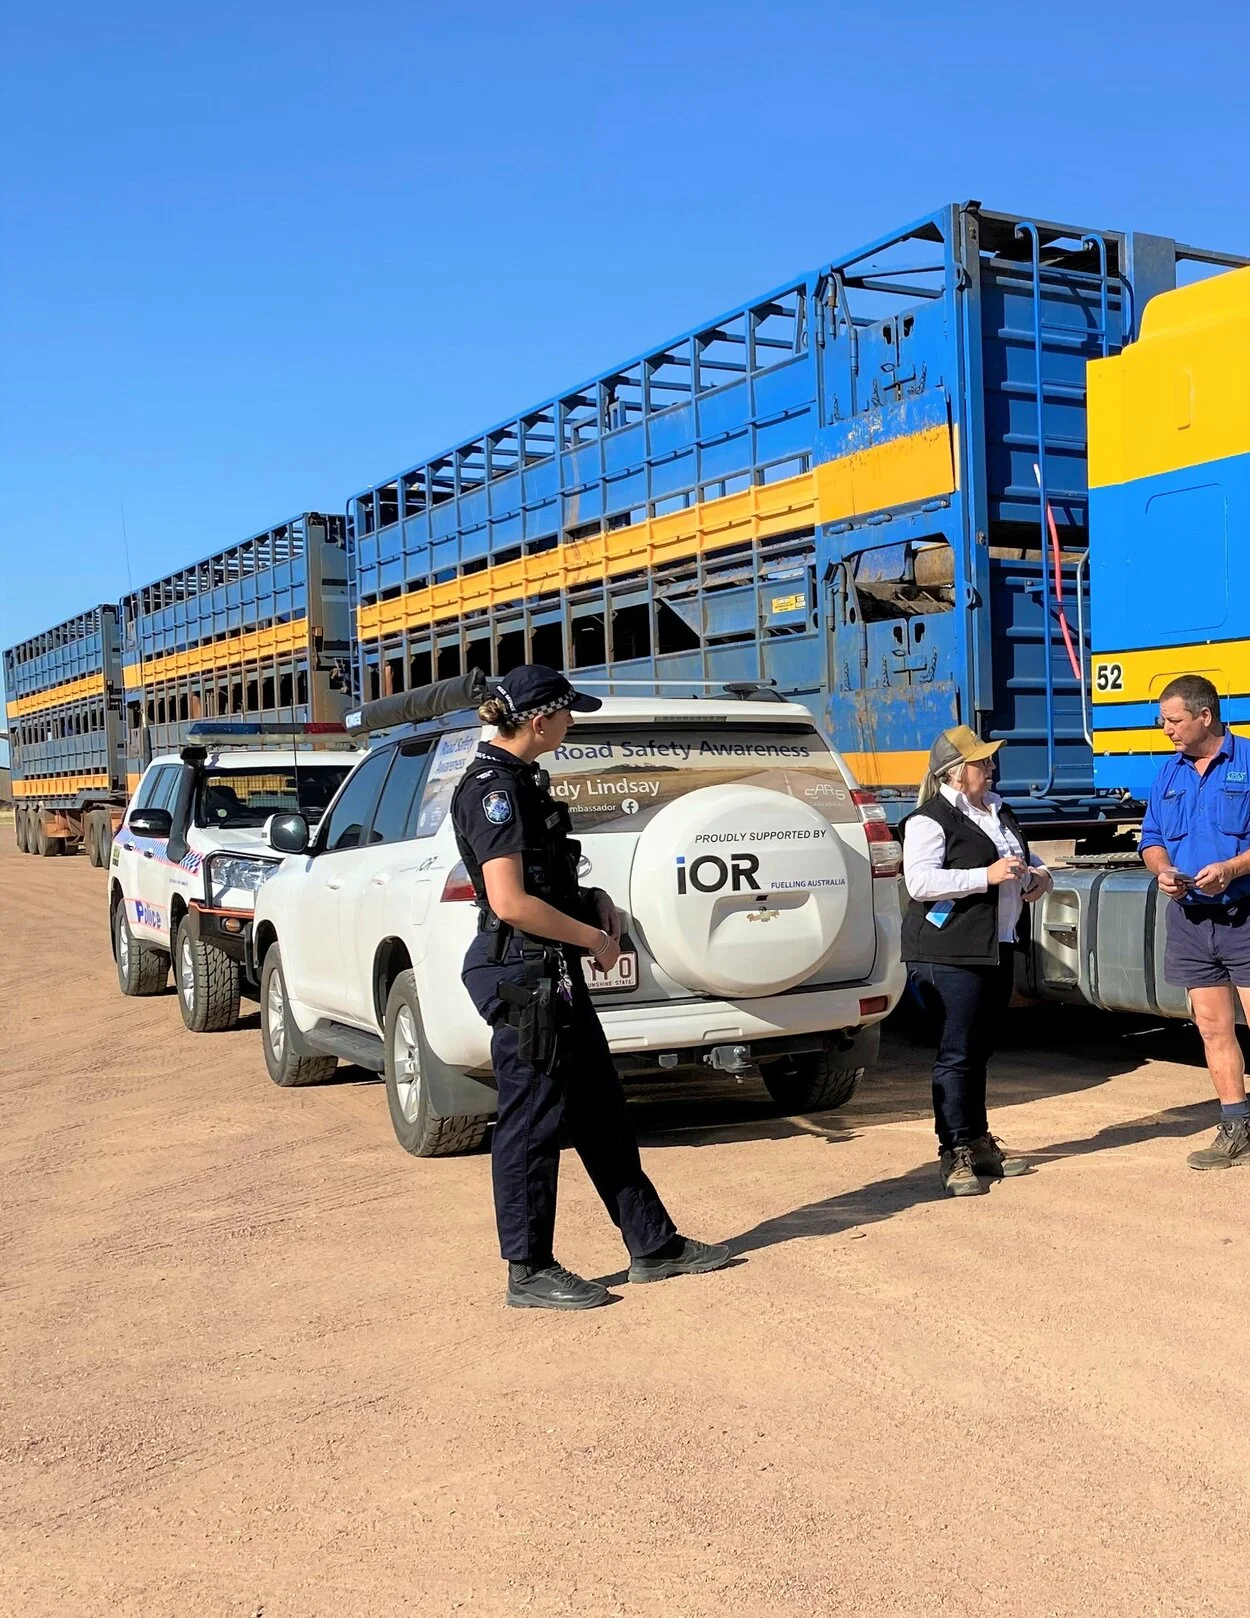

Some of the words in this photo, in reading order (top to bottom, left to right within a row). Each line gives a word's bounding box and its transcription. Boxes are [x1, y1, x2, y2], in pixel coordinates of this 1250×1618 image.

[1097, 664, 1122, 690] 52
[554, 743, 613, 760] Road
[622, 740, 691, 760] Safety
[699, 740, 811, 758] Awareness
[548, 780, 581, 801] udy
[586, 778, 660, 797] Lindsay
[567, 804, 617, 814] mbassador
[695, 833, 746, 844] PROUDLY
[749, 830, 811, 841] SUPPORTED
[812, 829, 827, 839] BY
[676, 853, 762, 895] iOR
[771, 881, 806, 889] FUELLING
[807, 879, 846, 887] AUSTRALIA
[135, 901, 161, 928] Police
